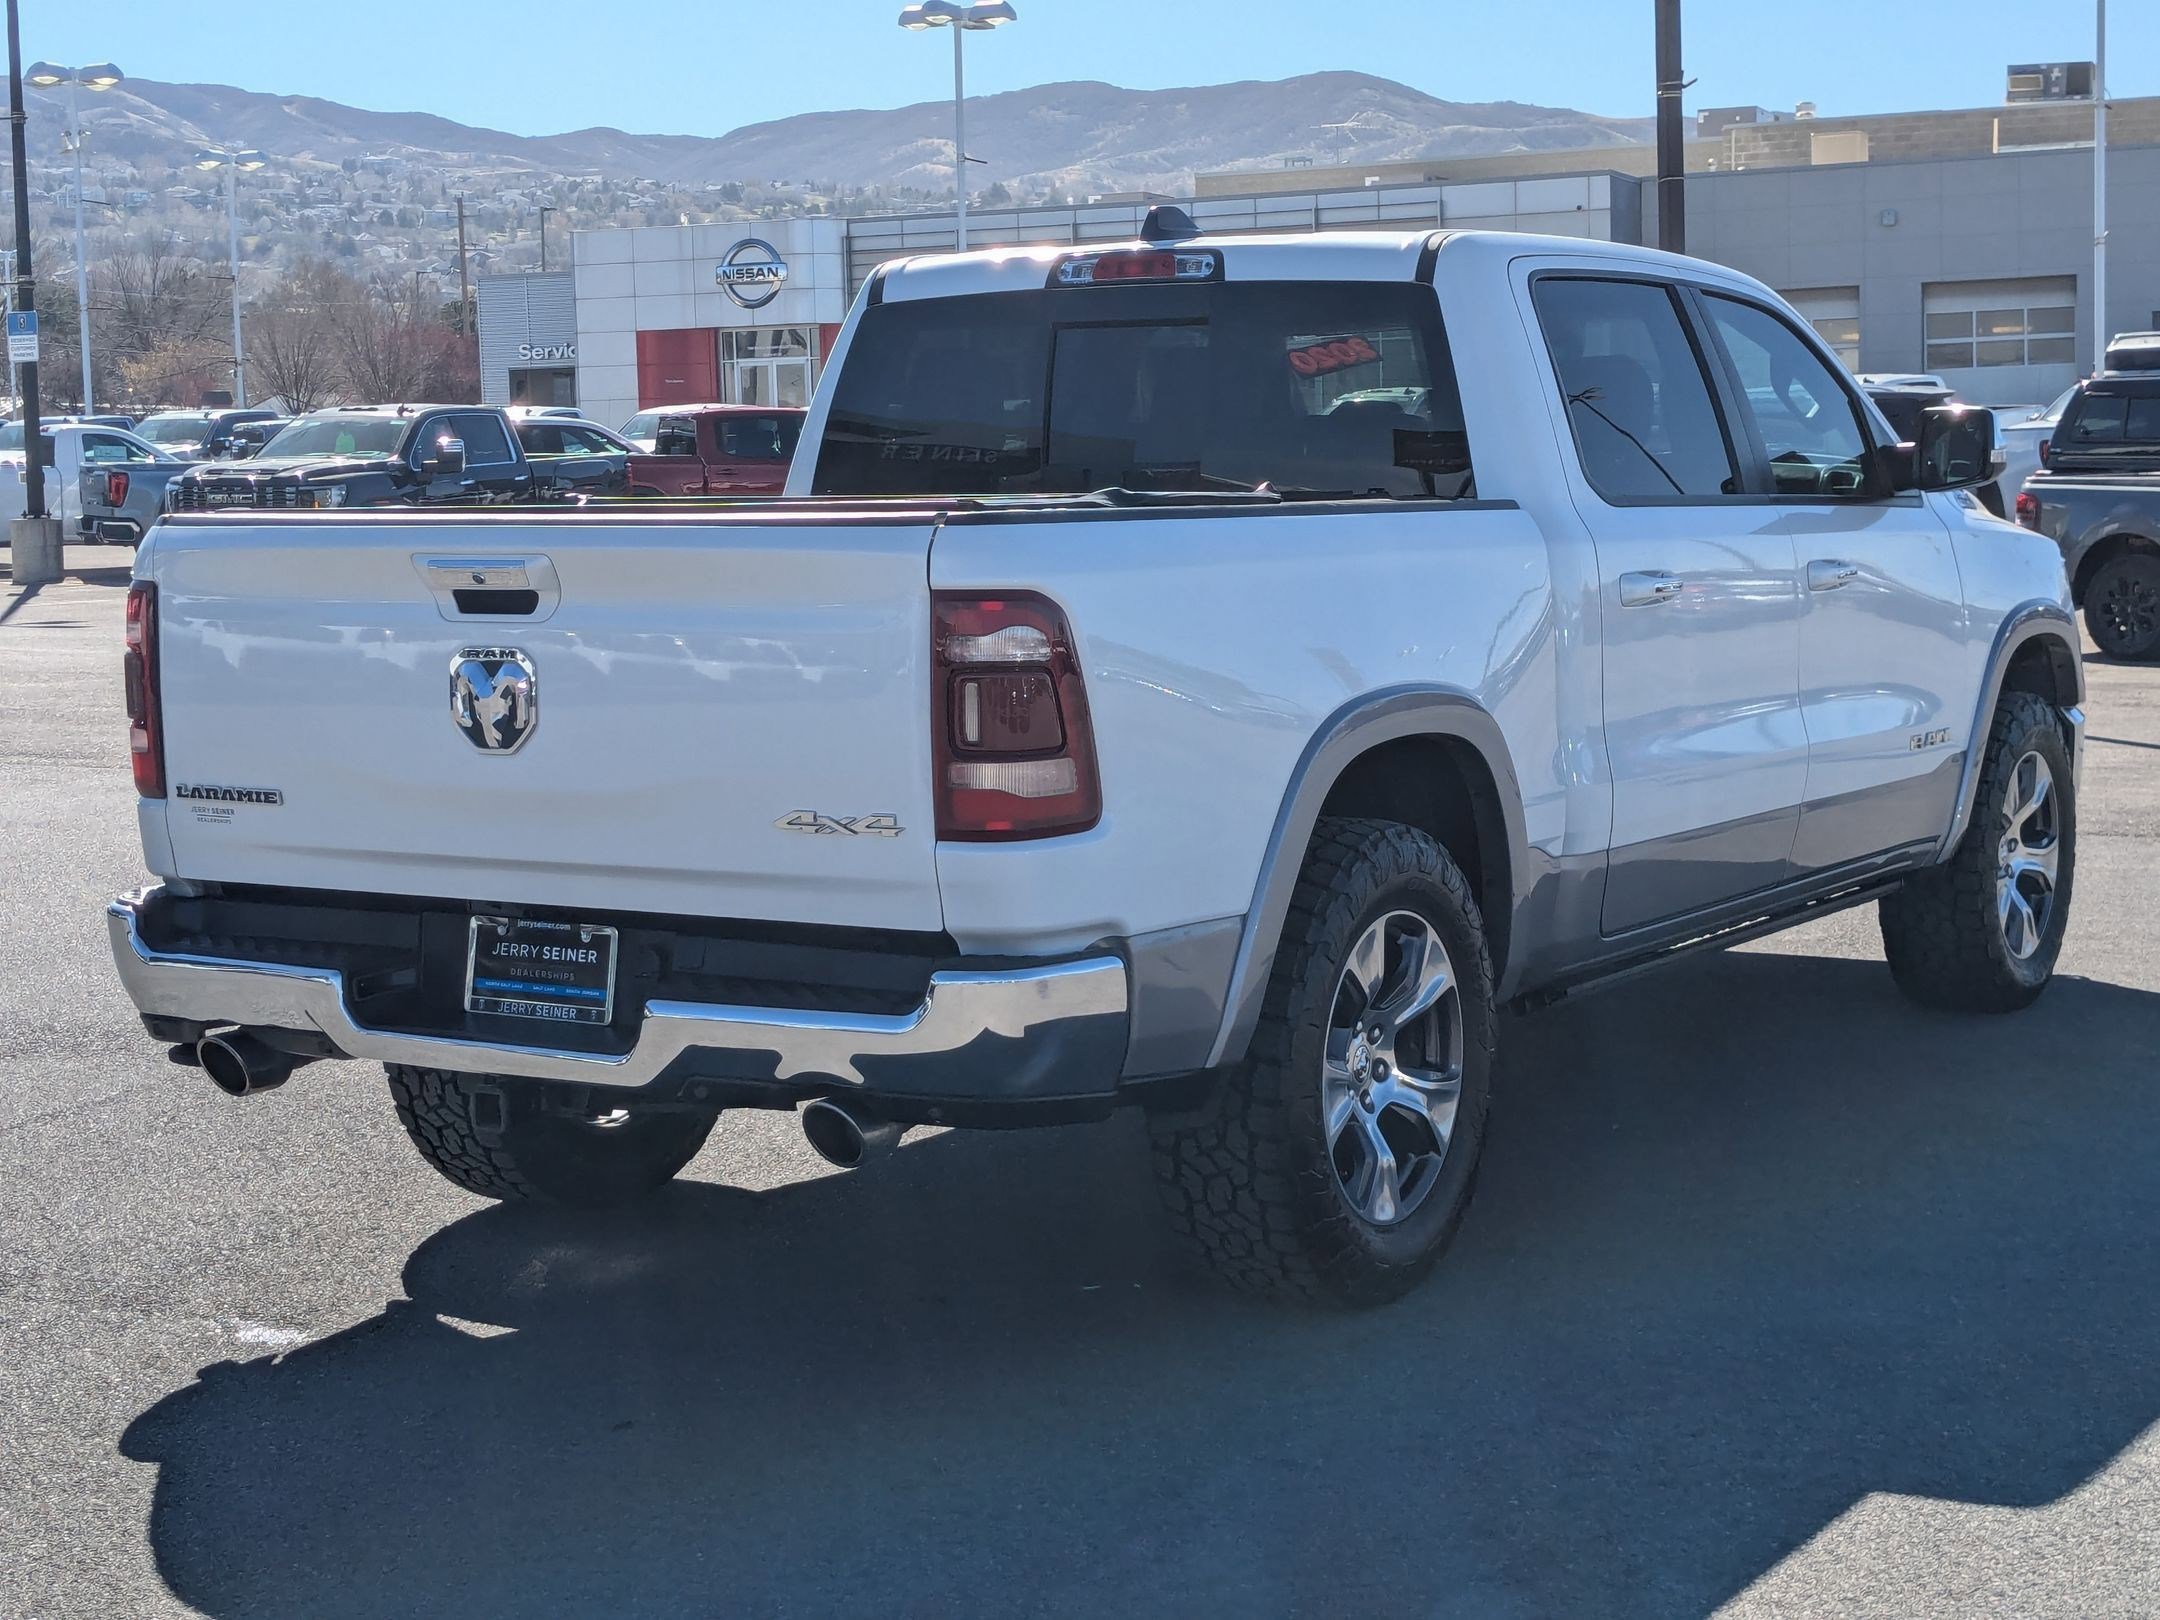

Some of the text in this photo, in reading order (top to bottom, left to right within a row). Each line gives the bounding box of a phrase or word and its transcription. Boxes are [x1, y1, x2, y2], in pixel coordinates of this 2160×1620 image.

[722, 266, 779, 280] NISSAN
[466, 649, 518, 659] RAM
[176, 784, 284, 805] LARAMIE
[191, 806, 235, 816] JERRY SEINER
[492, 942, 597, 963] JERRY SEINER
[510, 967, 576, 982] DEALERSHIPS
[497, 1001, 577, 1019] JERRY SEINER
